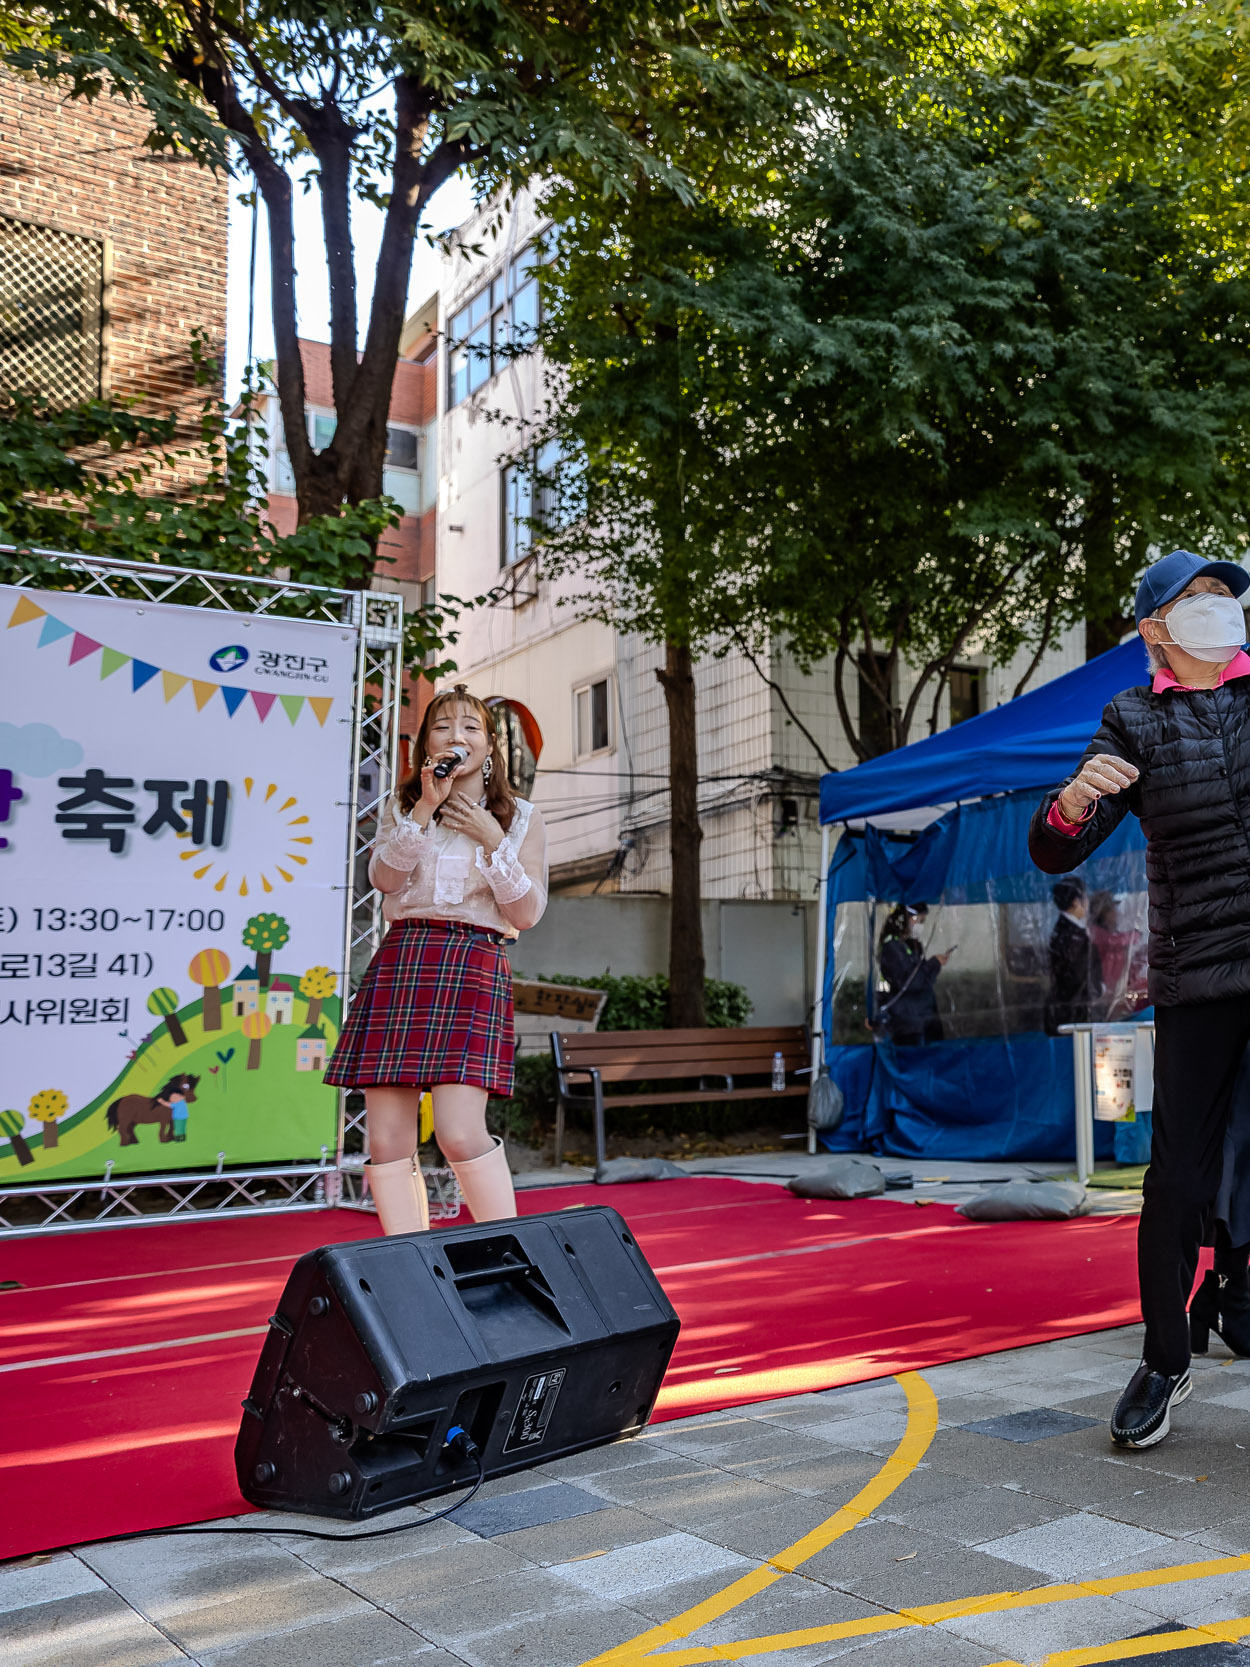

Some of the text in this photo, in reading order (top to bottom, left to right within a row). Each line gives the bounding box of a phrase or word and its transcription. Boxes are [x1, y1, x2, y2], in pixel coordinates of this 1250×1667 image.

[257, 650, 329, 672] 광진구
[55, 769, 228, 853] 축제
[33, 908, 225, 931] 13:30~17:00
[107, 953, 153, 978] 41)
[520, 1409, 538, 1440] Sx300
